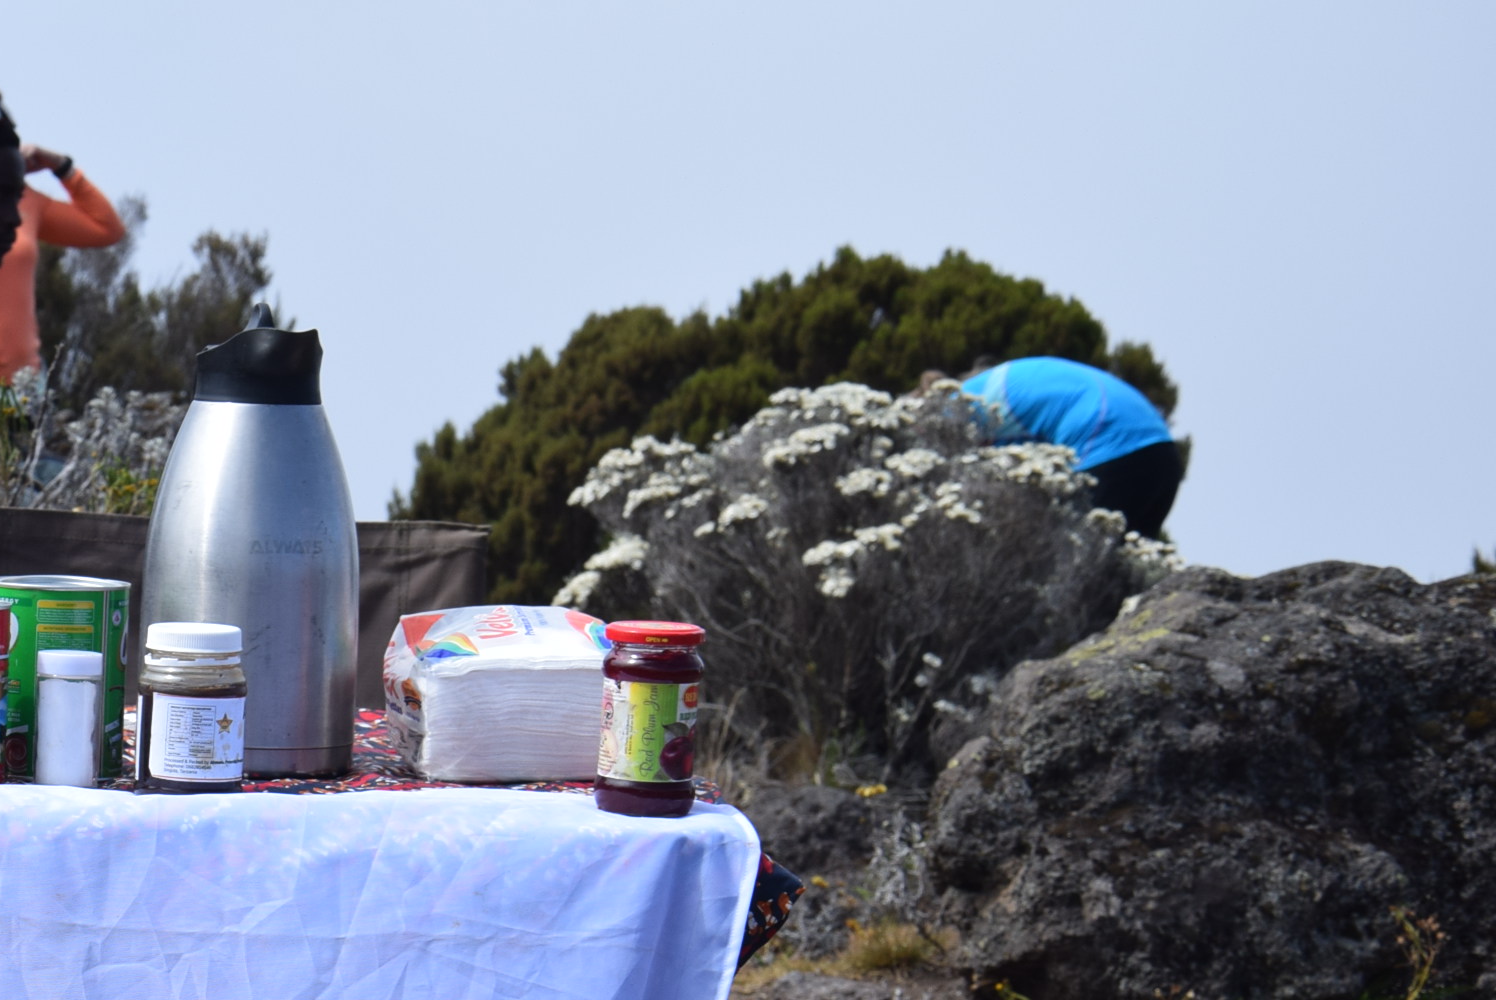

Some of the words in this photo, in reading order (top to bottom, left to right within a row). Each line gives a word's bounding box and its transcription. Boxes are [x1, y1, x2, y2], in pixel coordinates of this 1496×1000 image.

[644, 685, 661, 711] Jam
[642, 716, 657, 745] Plum
[639, 749, 653, 777] Red
